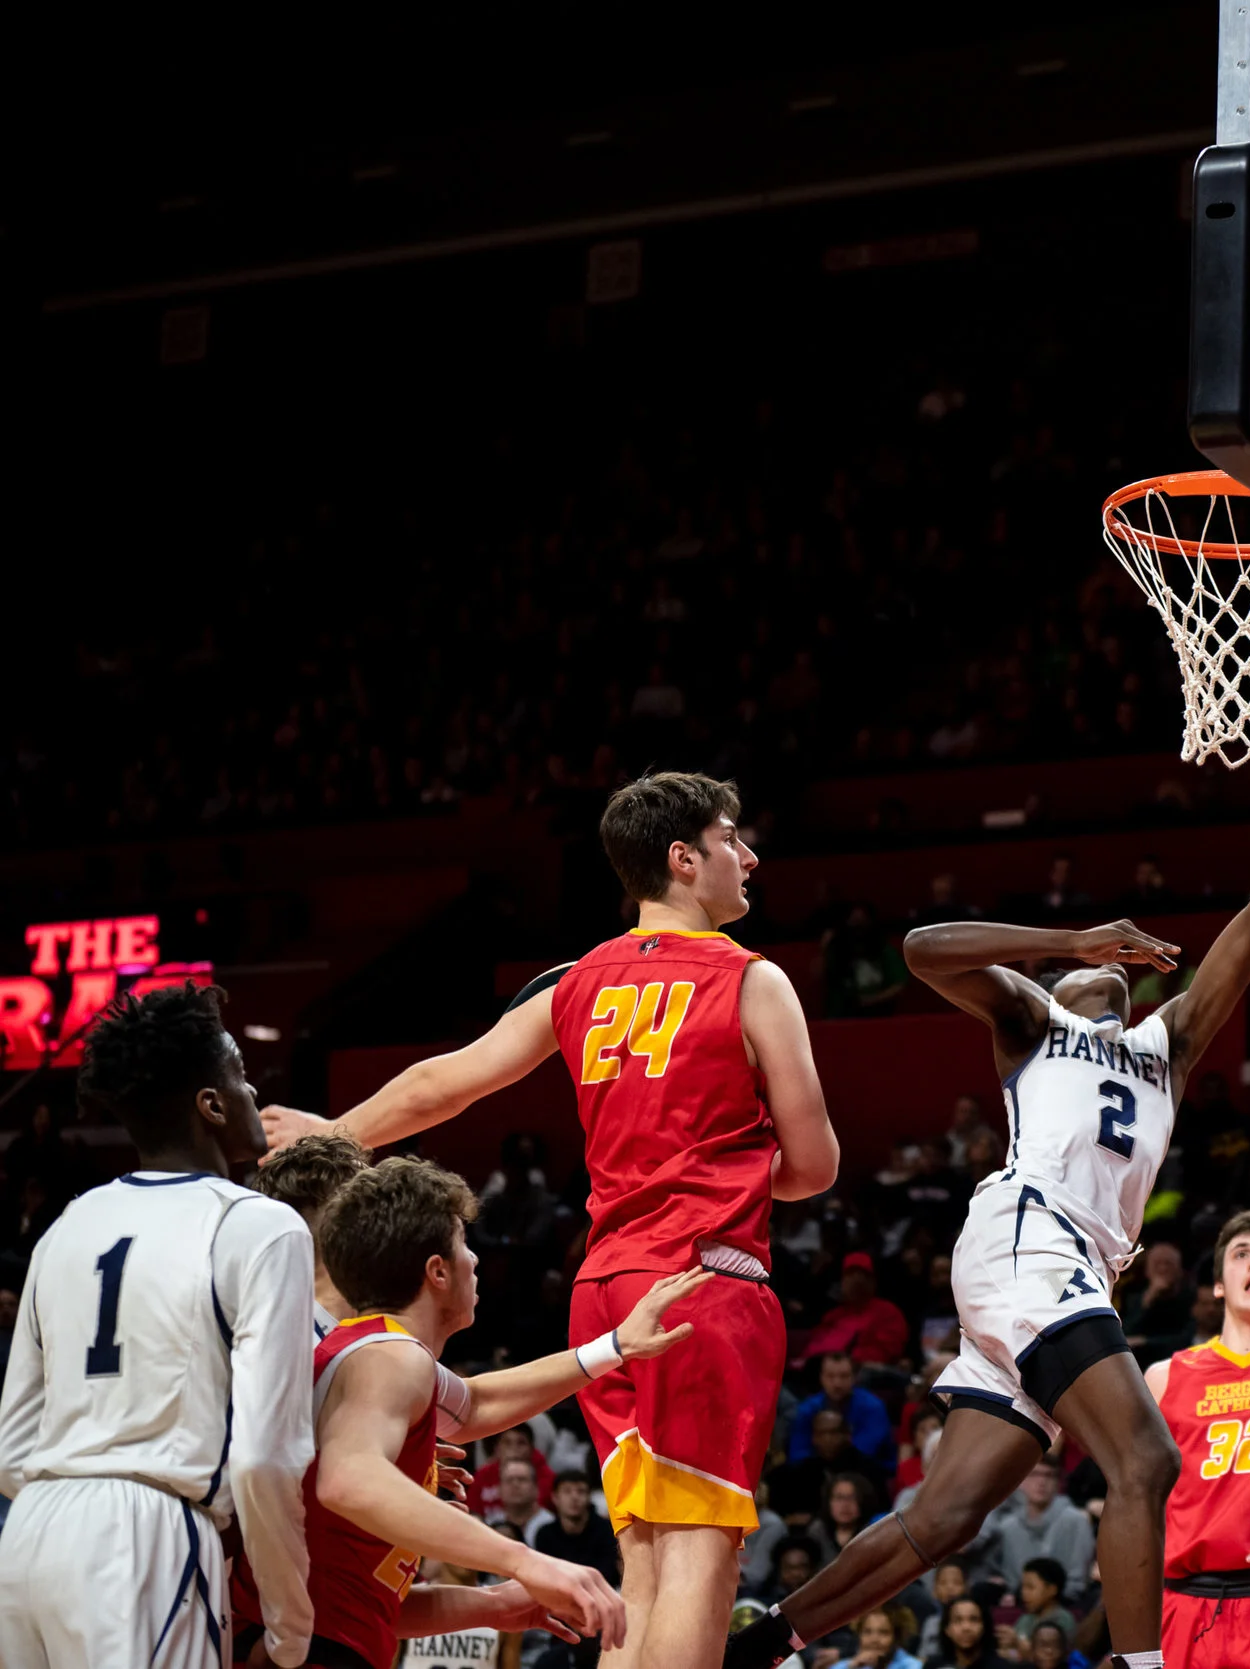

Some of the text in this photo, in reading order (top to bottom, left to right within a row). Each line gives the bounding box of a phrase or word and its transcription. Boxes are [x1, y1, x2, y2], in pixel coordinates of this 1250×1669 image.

[24, 913, 161, 976] THE
[581, 981, 696, 1085] 24
[1096, 1079, 1138, 1162] 2
[85, 1235, 136, 1379] 1
